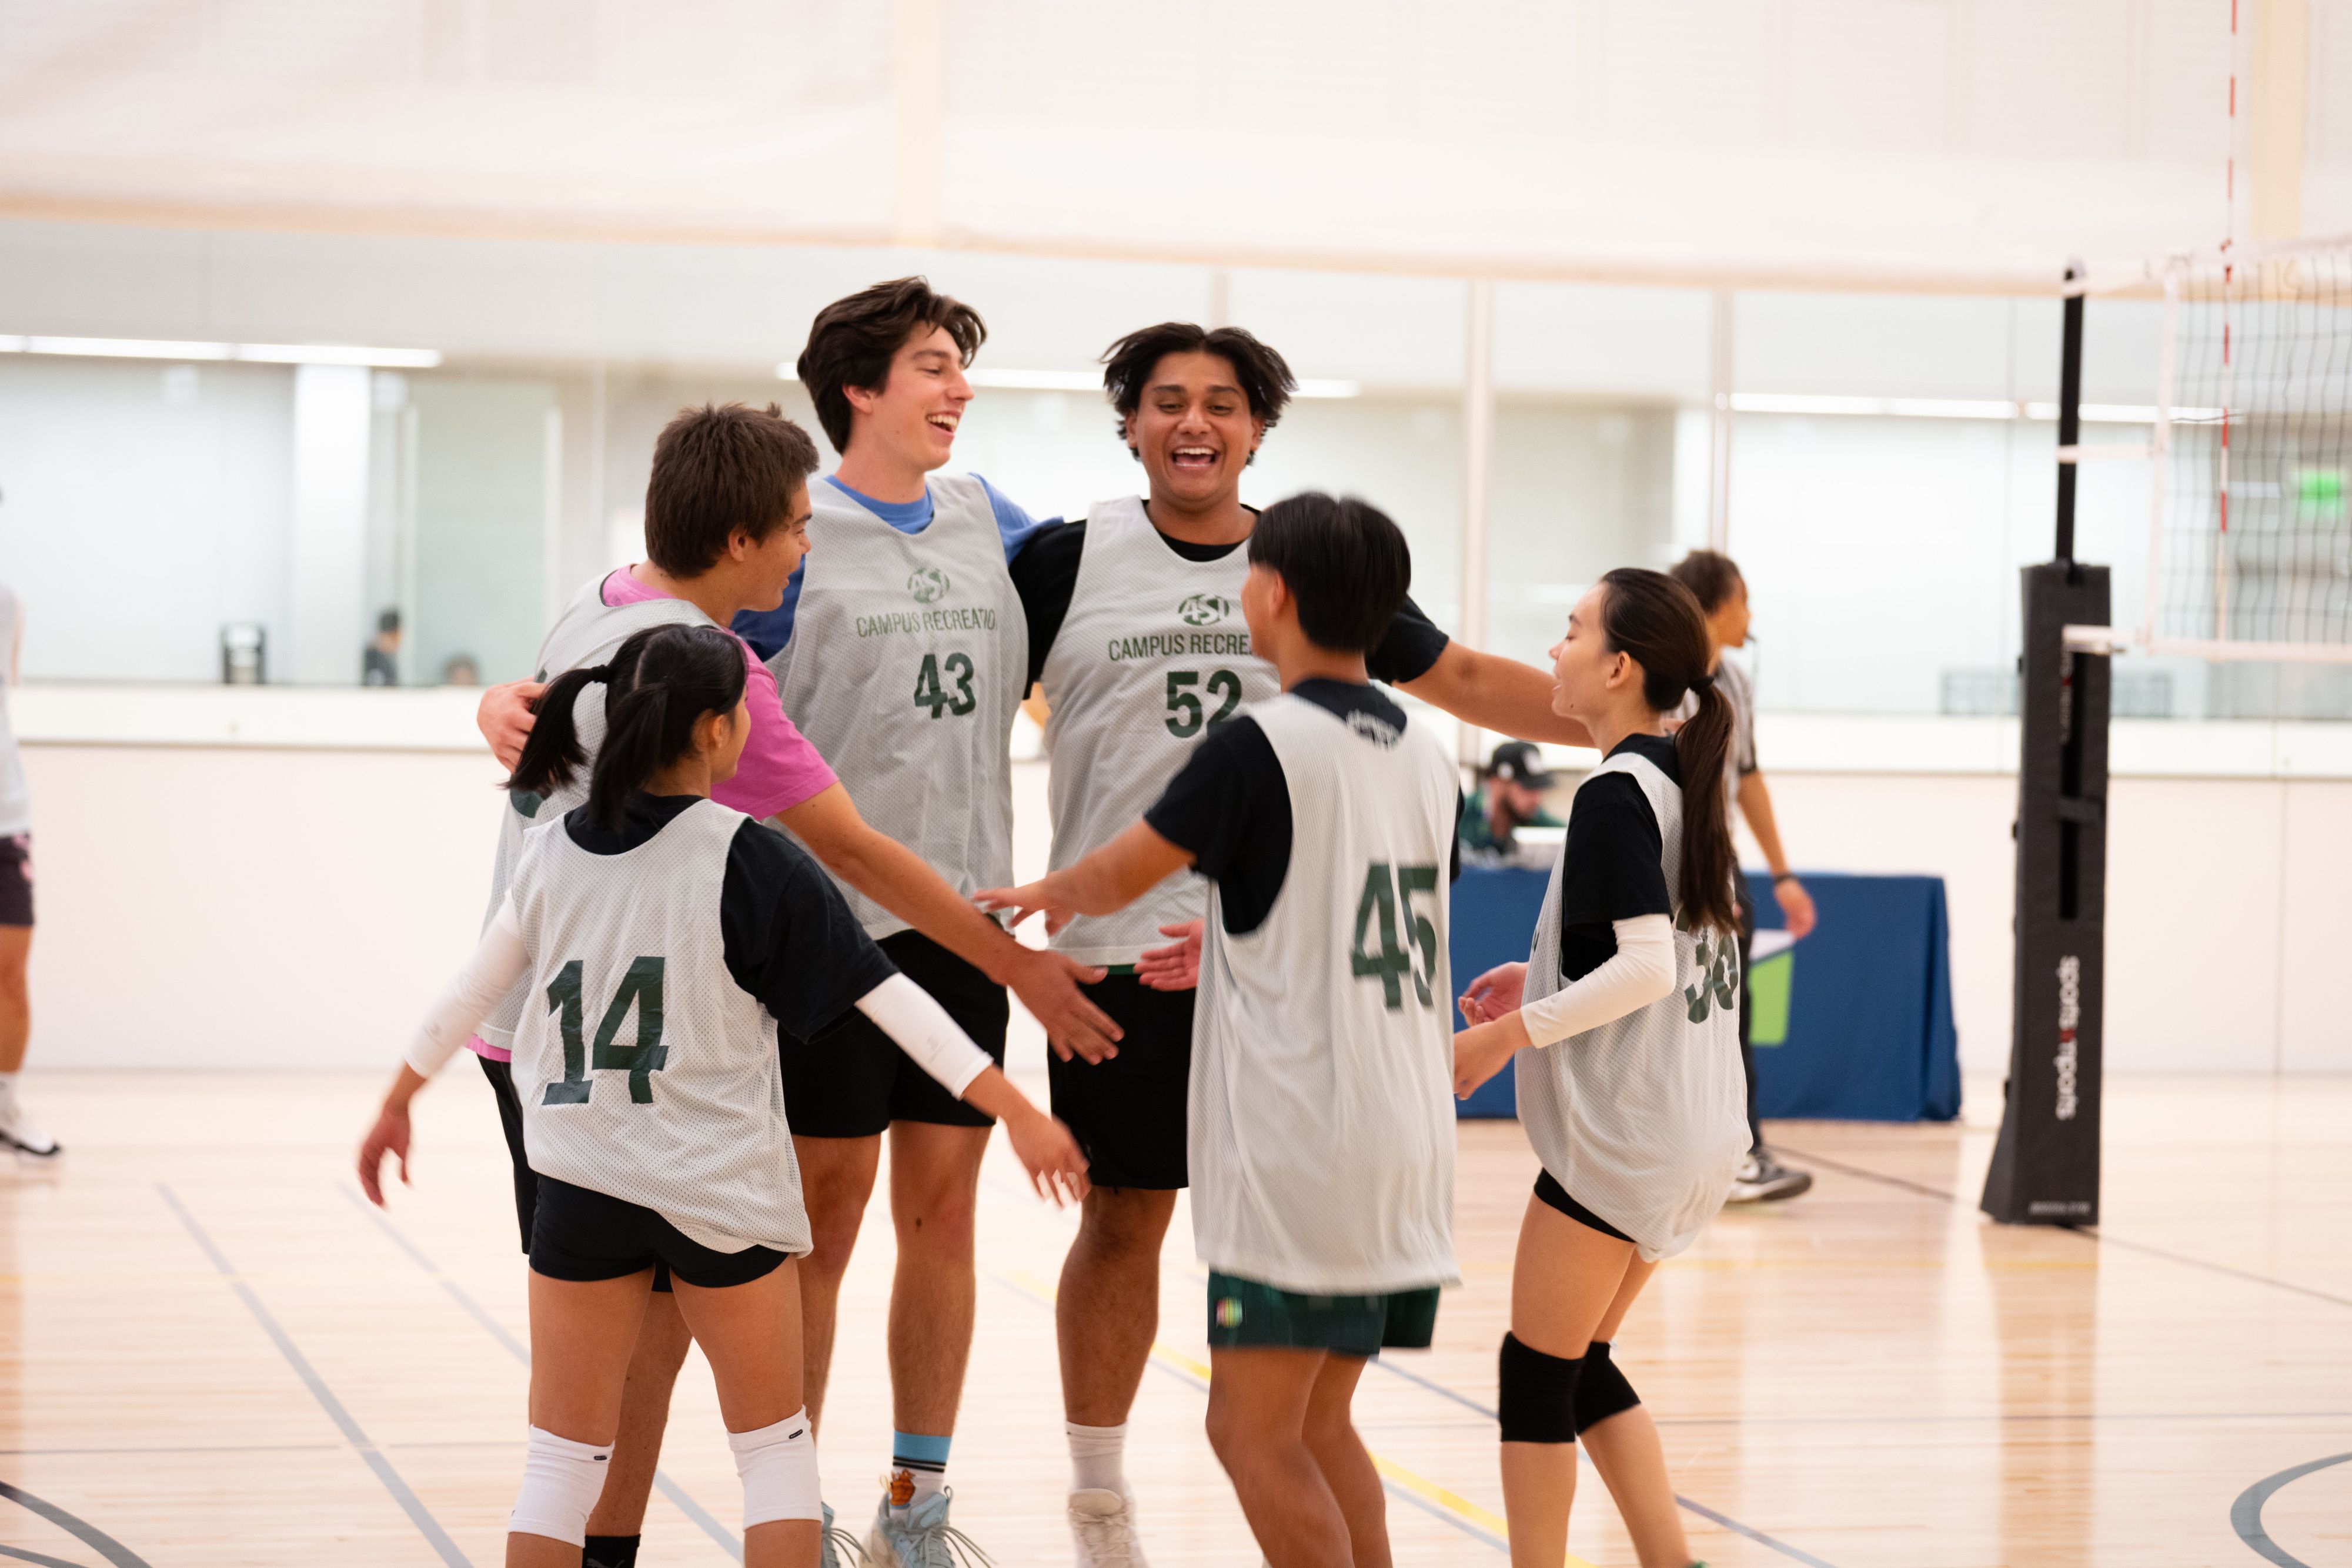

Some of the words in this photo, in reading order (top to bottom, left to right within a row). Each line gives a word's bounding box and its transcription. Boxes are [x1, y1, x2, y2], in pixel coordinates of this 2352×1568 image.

[856, 611, 921, 638] CAMPUS
[923, 607, 998, 631] RECREATIO
[1108, 633, 1185, 661] CAMPUS
[1190, 633, 1252, 656] RECRE
[913, 651, 976, 719] 43
[1165, 669, 1242, 738] 52
[1351, 861, 1439, 1011] 45
[541, 955, 670, 1105] 14
